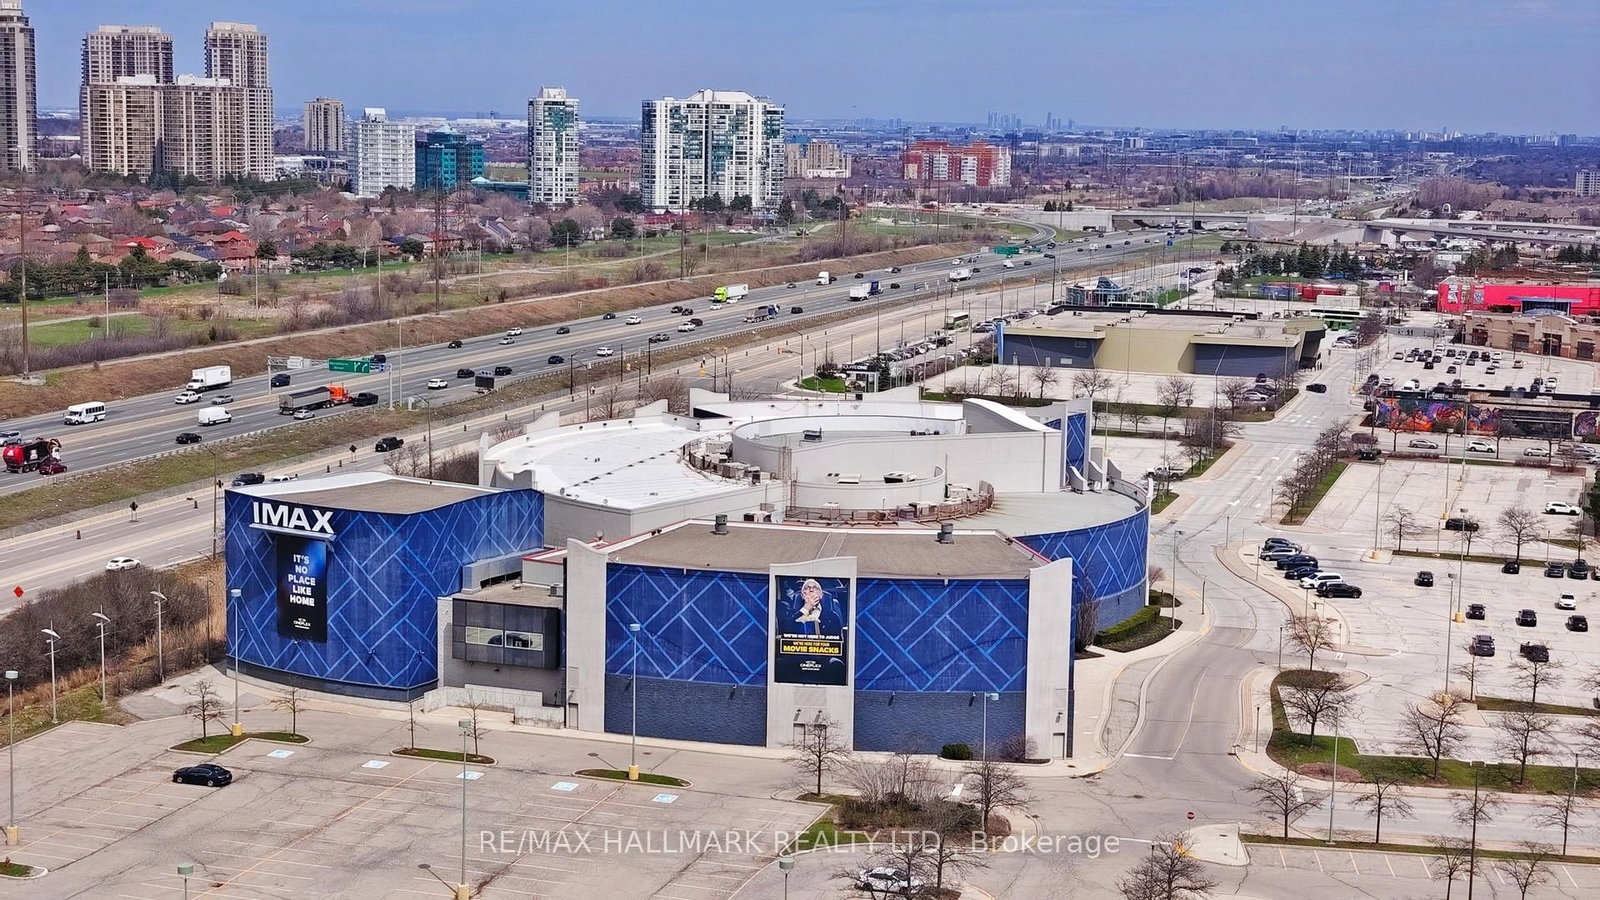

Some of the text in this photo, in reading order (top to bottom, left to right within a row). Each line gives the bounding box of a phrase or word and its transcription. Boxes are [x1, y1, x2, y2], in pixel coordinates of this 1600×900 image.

[253, 502, 334, 534] IMAX
[294, 554, 310, 564] IT'S
[295, 564, 308, 574] NO
[288, 574, 316, 586] PLACE
[292, 584, 312, 596] LIKE
[290, 594, 315, 606] HOME
